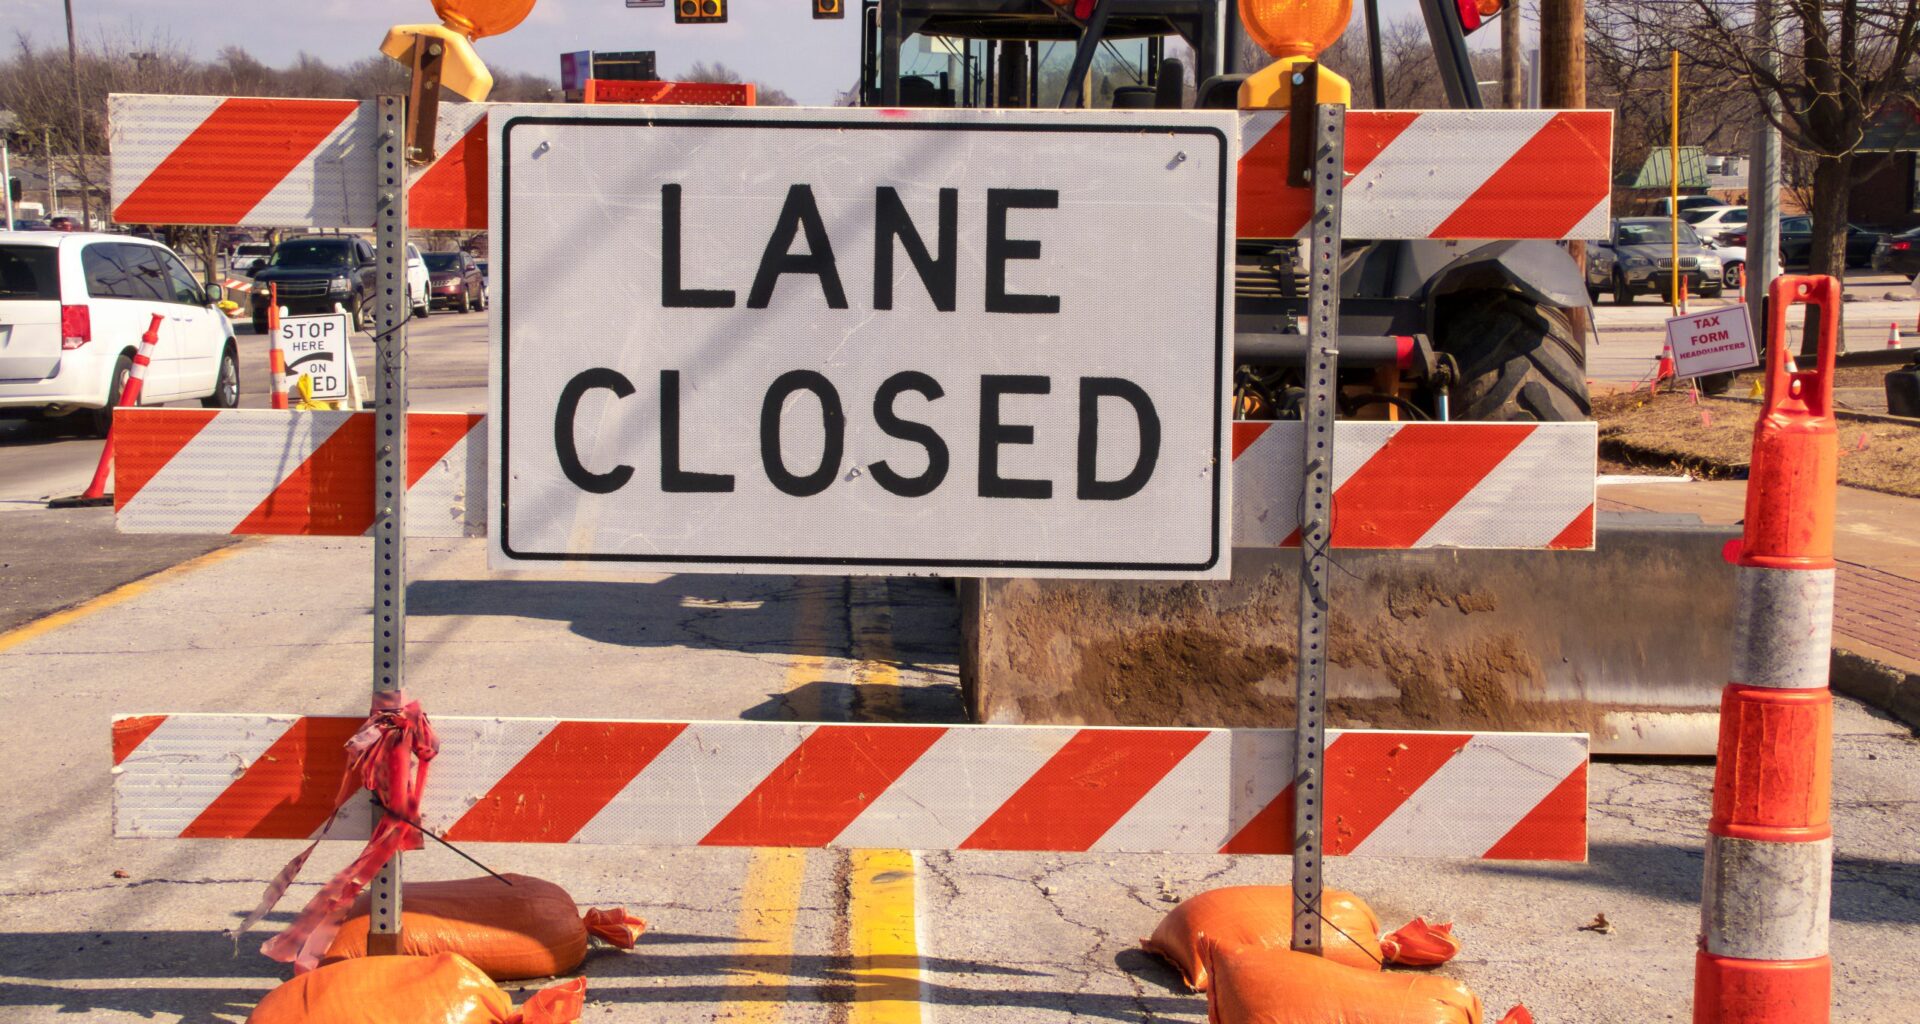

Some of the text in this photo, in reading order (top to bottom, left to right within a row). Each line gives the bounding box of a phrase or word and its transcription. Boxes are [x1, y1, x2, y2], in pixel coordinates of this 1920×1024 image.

[661, 184, 1060, 314] LANE
[283, 322, 334, 339] STOP
[1693, 316, 1721, 329] TAX
[293, 340, 325, 351] HERE
[1690, 330, 1729, 346] FORM
[1679, 342, 1746, 360] HEADQUARTERS
[310, 363, 326, 373] ON
[313, 376, 337, 392] ED
[555, 367, 1161, 501] CLOSED
